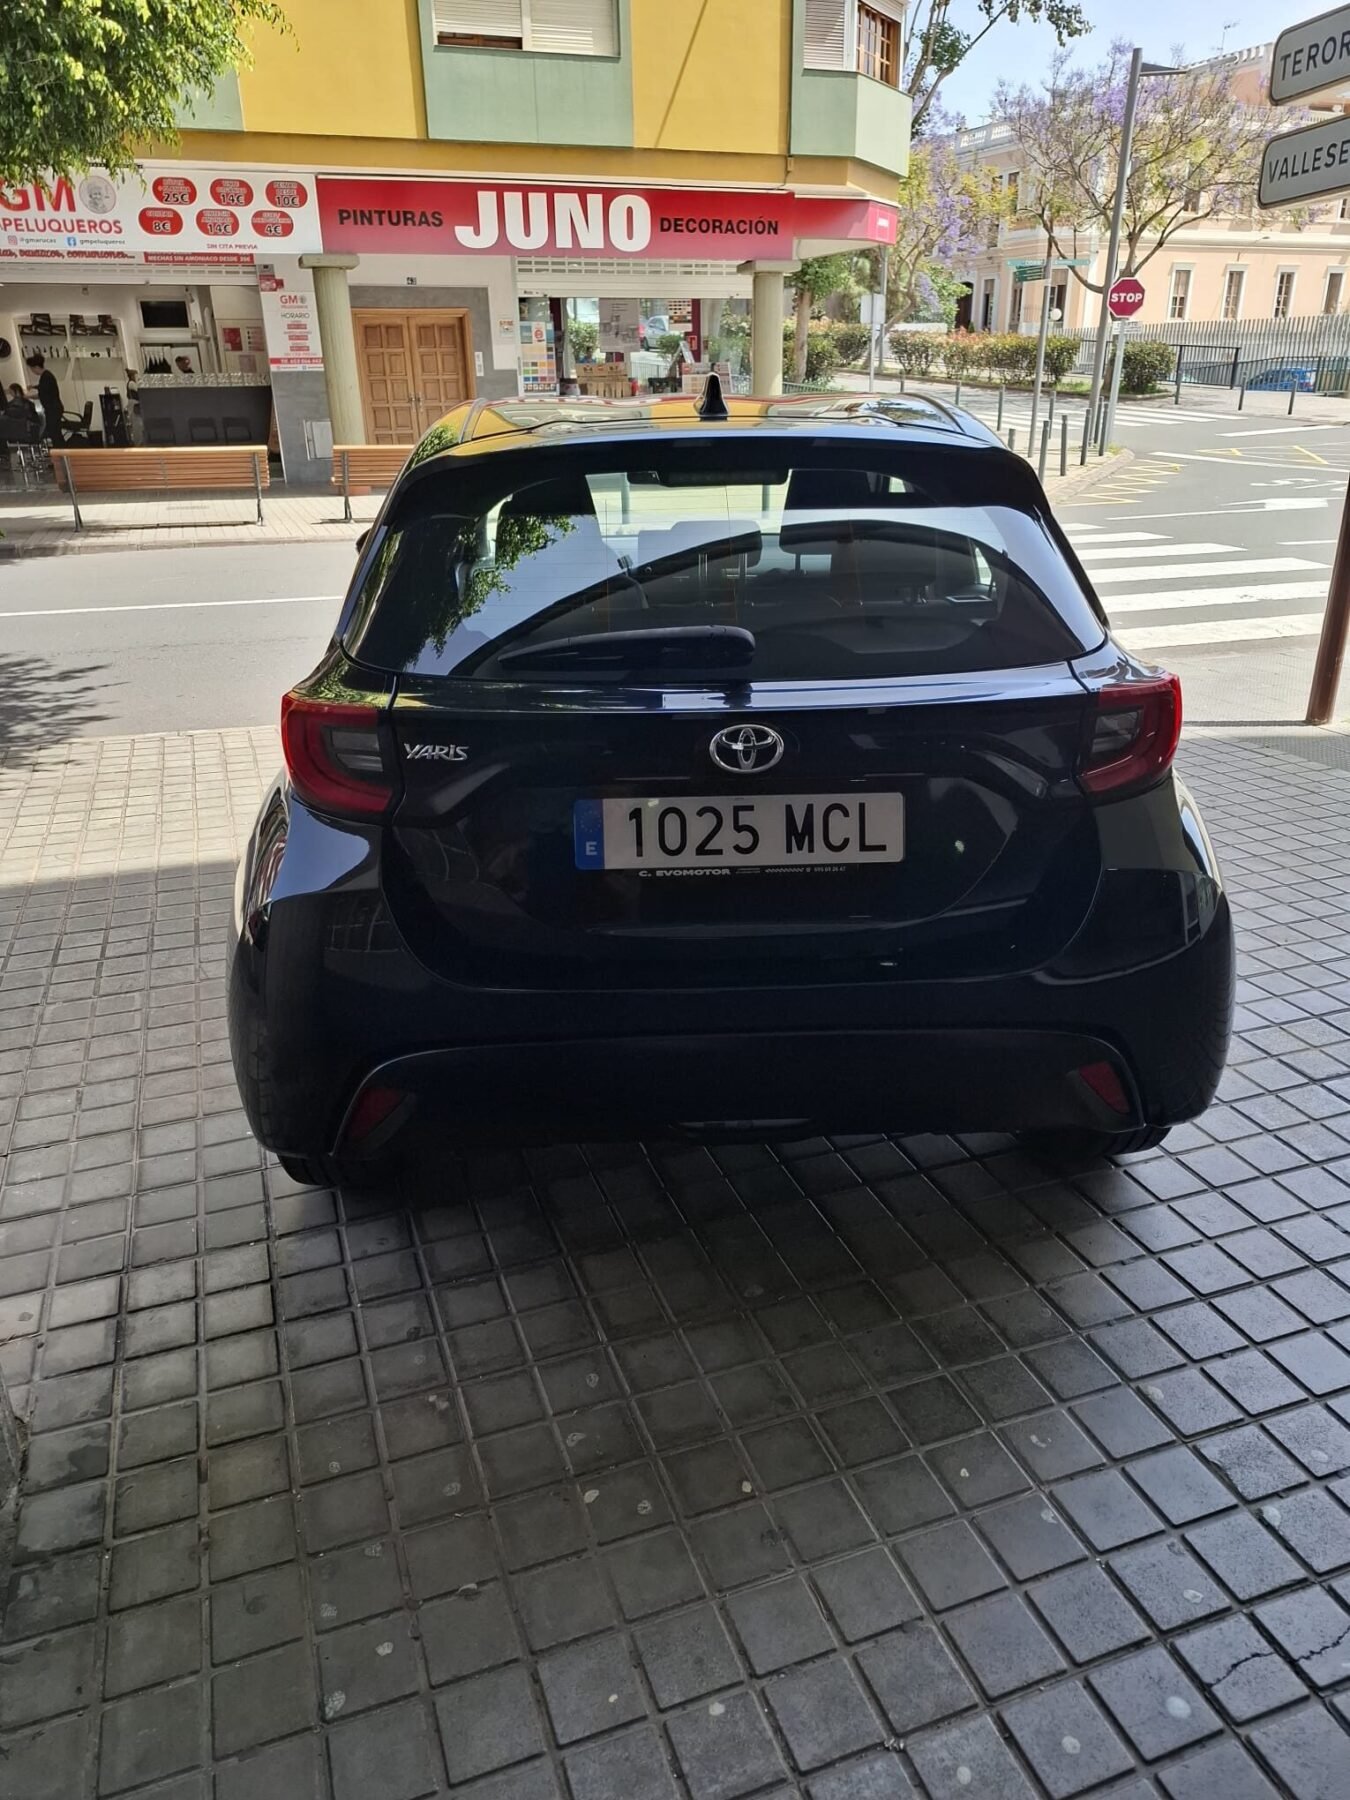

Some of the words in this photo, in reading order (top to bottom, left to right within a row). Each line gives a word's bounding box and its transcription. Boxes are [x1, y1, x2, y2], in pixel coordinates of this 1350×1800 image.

[1279, 30, 1350, 82] TEROR
[1268, 139, 1350, 184] VALLESE
[163, 192, 189, 203] 25€
[220, 193, 245, 204] 14€
[276, 195, 300, 206] 10€
[153, 221, 171, 231] 8€
[338, 208, 444, 228] PINTURAS
[455, 191, 652, 252] JUNO
[659, 215, 779, 236] DECORACIÓN
[207, 223, 232, 234] 14€
[265, 224, 282, 235] 4€
[280, 295, 298, 304] GM
[1110, 292, 1143, 303] STOP
[403, 743, 469, 761] YARIS
[629, 804, 760, 858] 1025
[785, 801, 887, 854] MCL
[584, 841, 598, 856] E
[655, 868, 731, 877] EVOMOTOR
